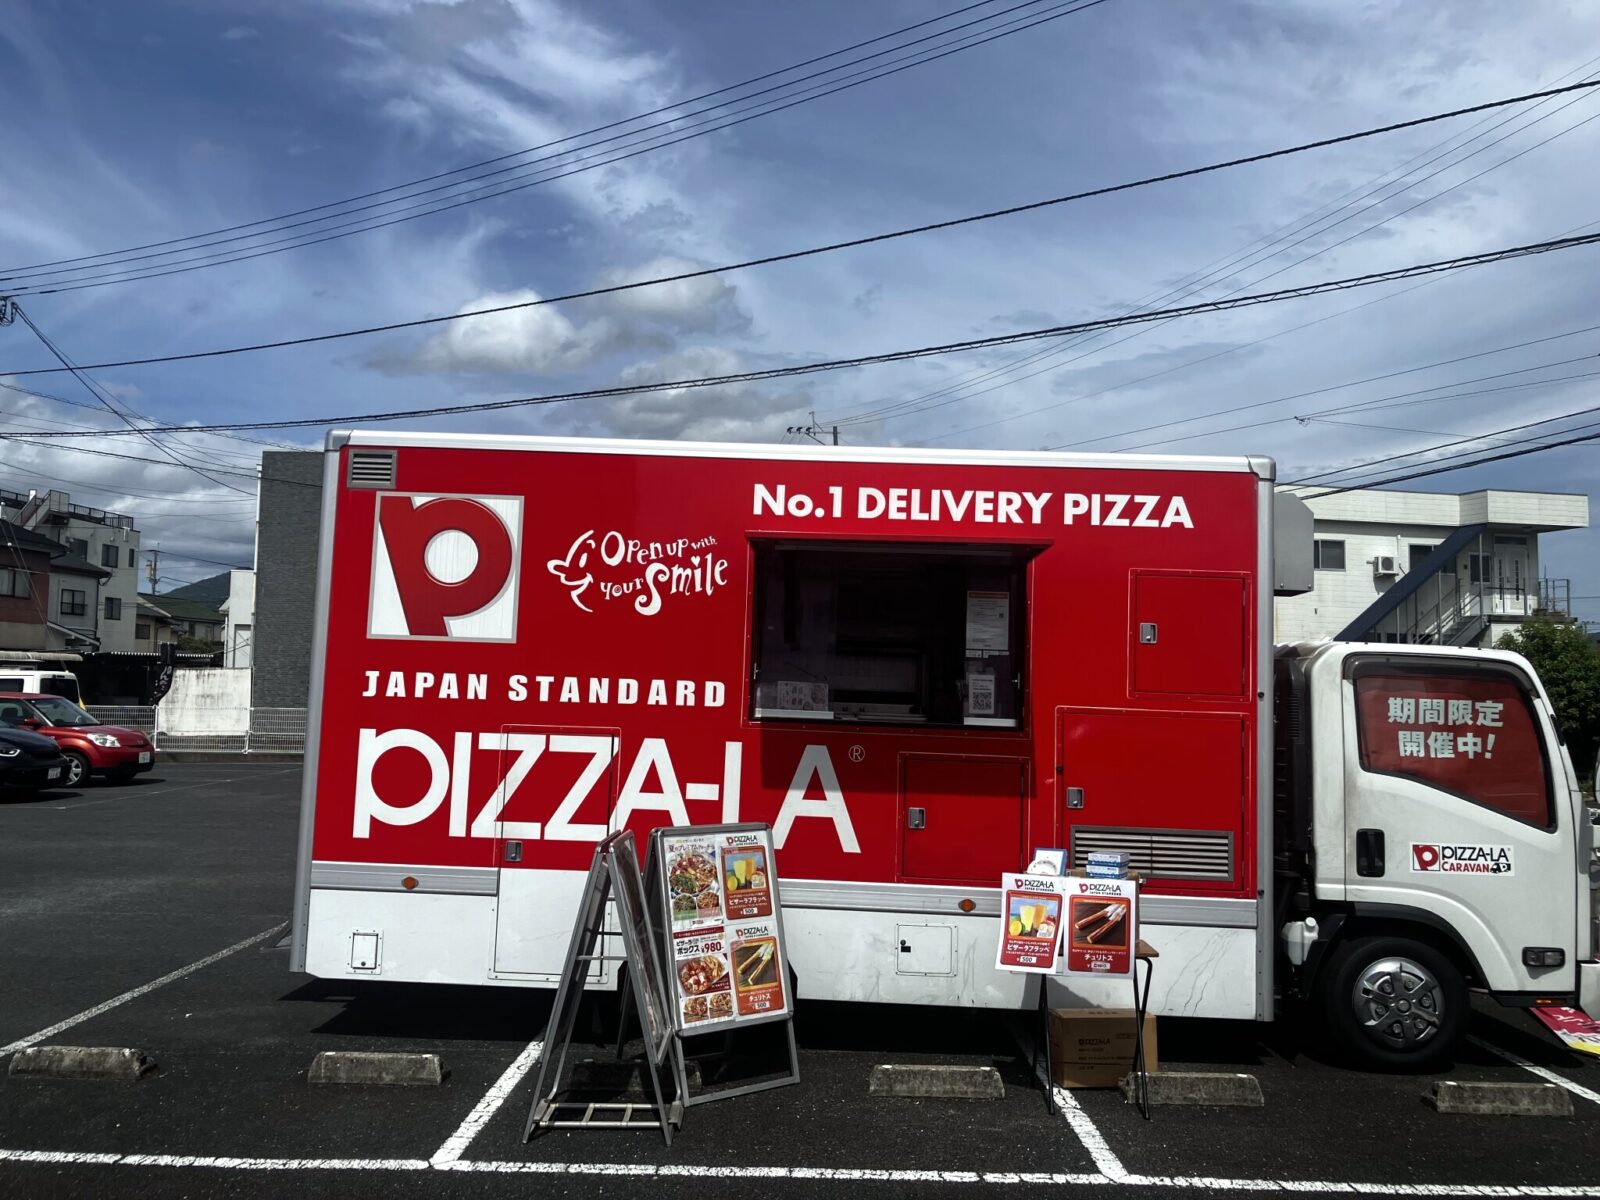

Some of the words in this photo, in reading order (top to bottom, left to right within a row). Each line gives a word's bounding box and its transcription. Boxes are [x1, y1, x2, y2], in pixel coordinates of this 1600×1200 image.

[752, 483, 842, 518] No.1
[857, 486, 1053, 524] DELIVERY
[1063, 492, 1195, 529] PIZZA
[600, 530, 664, 567] Open
[666, 538, 688, 558] up
[690, 536, 718, 550] with
[600, 577, 644, 600] your
[634, 552, 729, 616] Smile
[362, 670, 488, 700] JAPAN
[508, 674, 726, 707] STANDARD
[1387, 697, 1504, 728] 期間限定
[1397, 730, 1496, 760] 開催中!
[1441, 861, 1490, 873] CARAVAN
[1024, 879, 1054, 889] PIZZA-LA
[1089, 883, 1122, 892] PIZZA-LA
[1084, 953, 1113, 961] チュリトス
